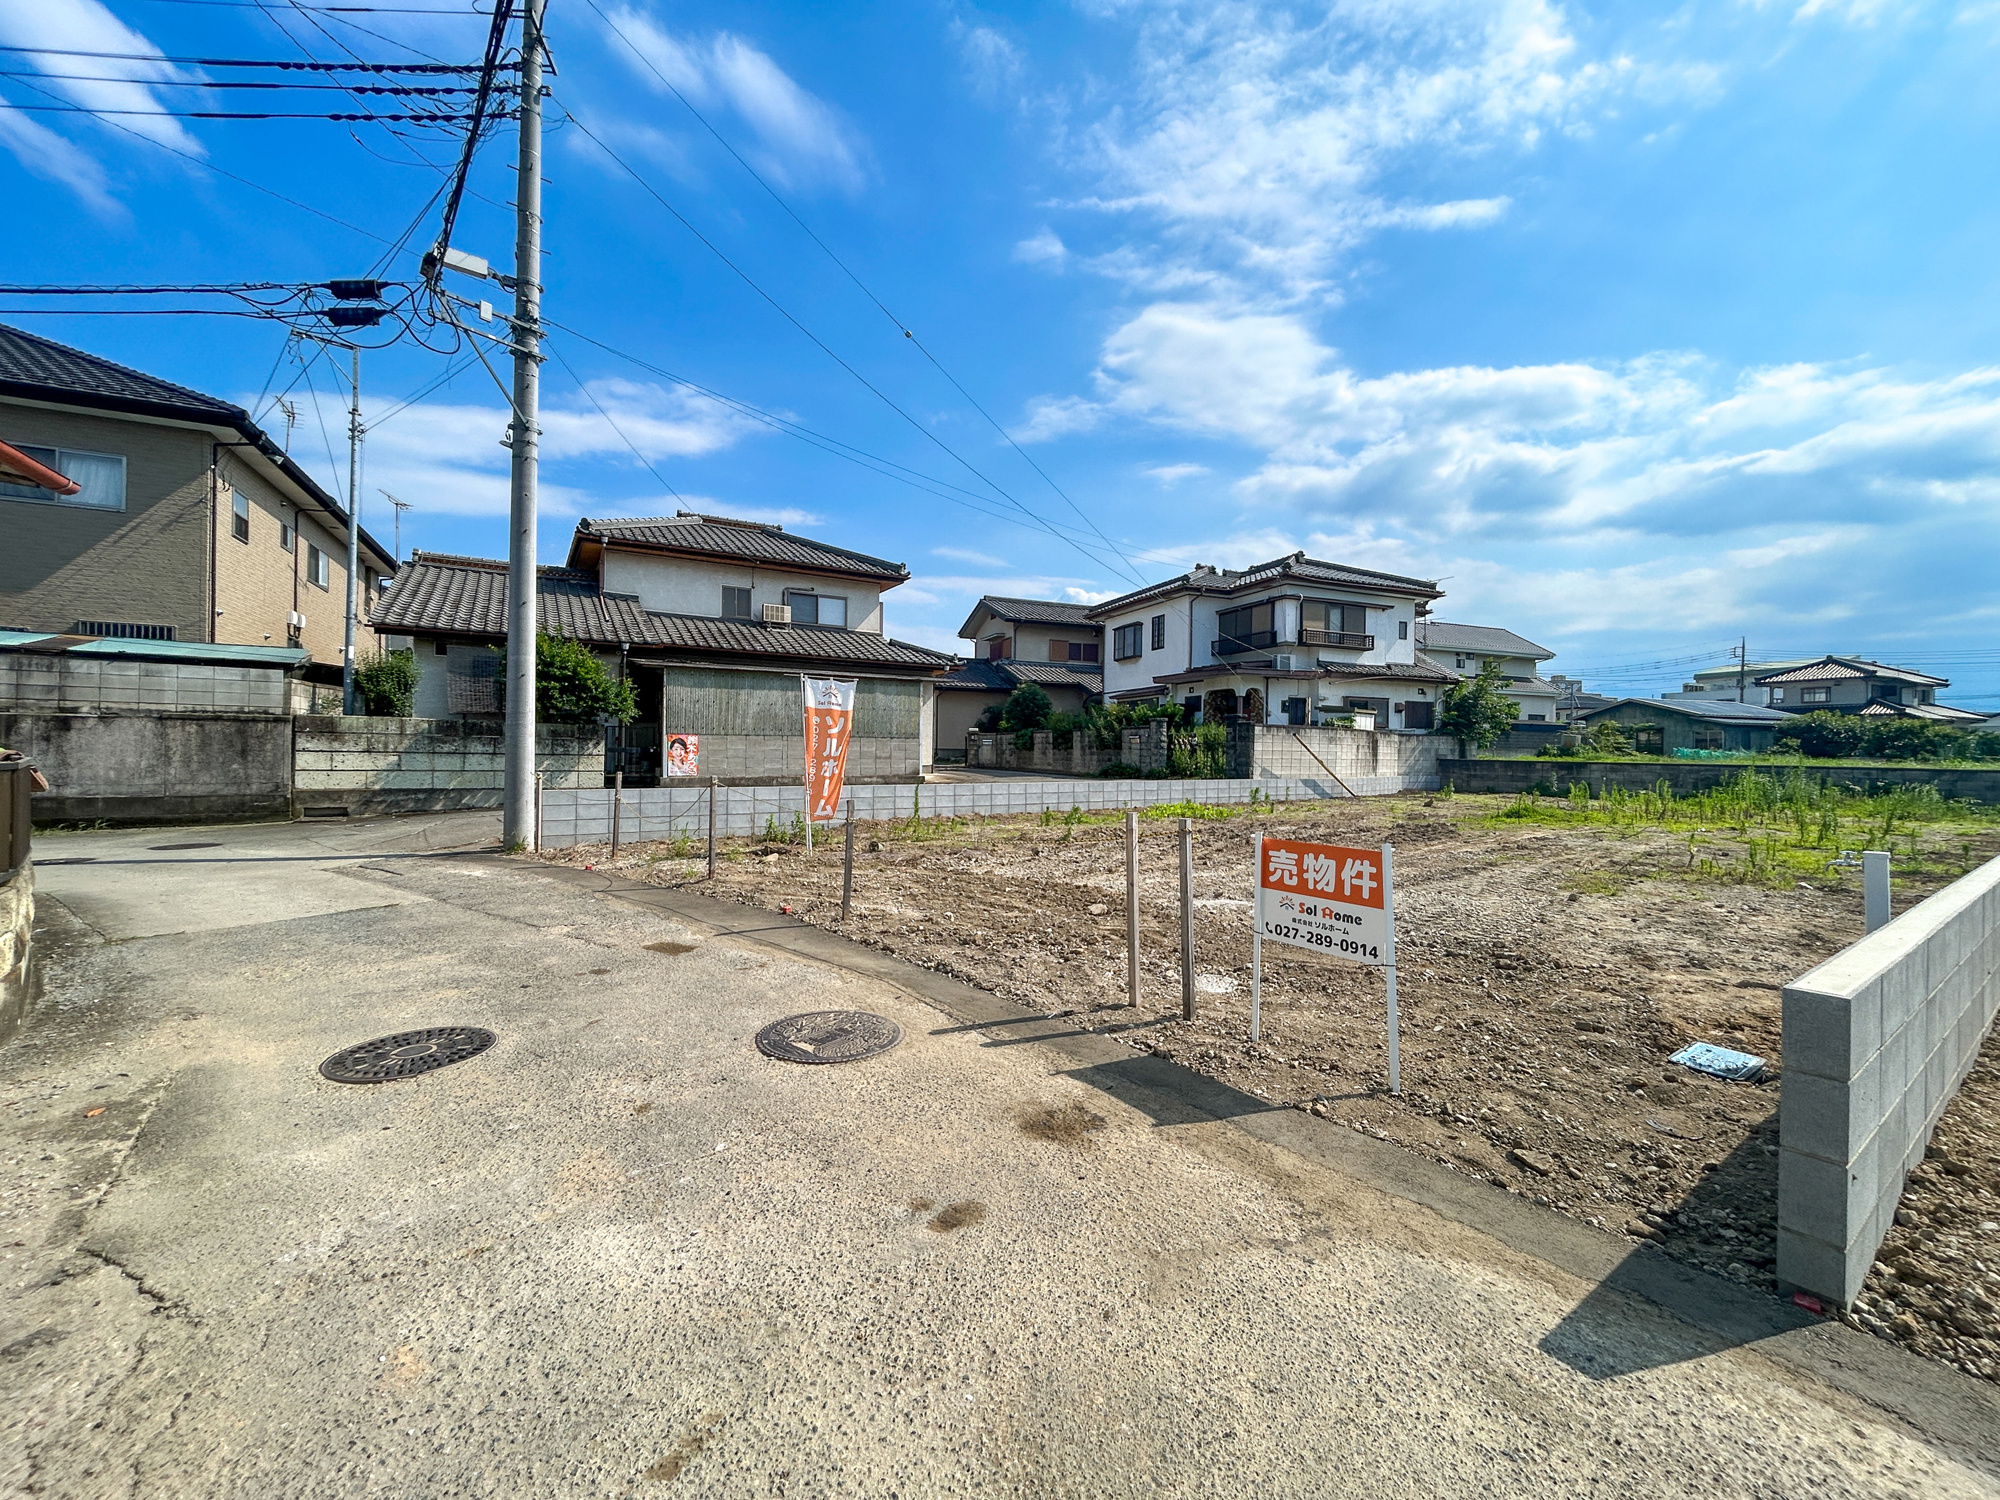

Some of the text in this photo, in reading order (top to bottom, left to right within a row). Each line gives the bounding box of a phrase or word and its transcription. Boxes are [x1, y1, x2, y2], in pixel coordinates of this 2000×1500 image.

[813, 715, 845, 817] ソルホーム
[1268, 849, 1378, 900] 売物件
[1291, 917, 1350, 936] 株式会社 ソルホーム
[1298, 902, 1317, 917] Sol
[1274, 923, 1379, 959] 027-289-0914
